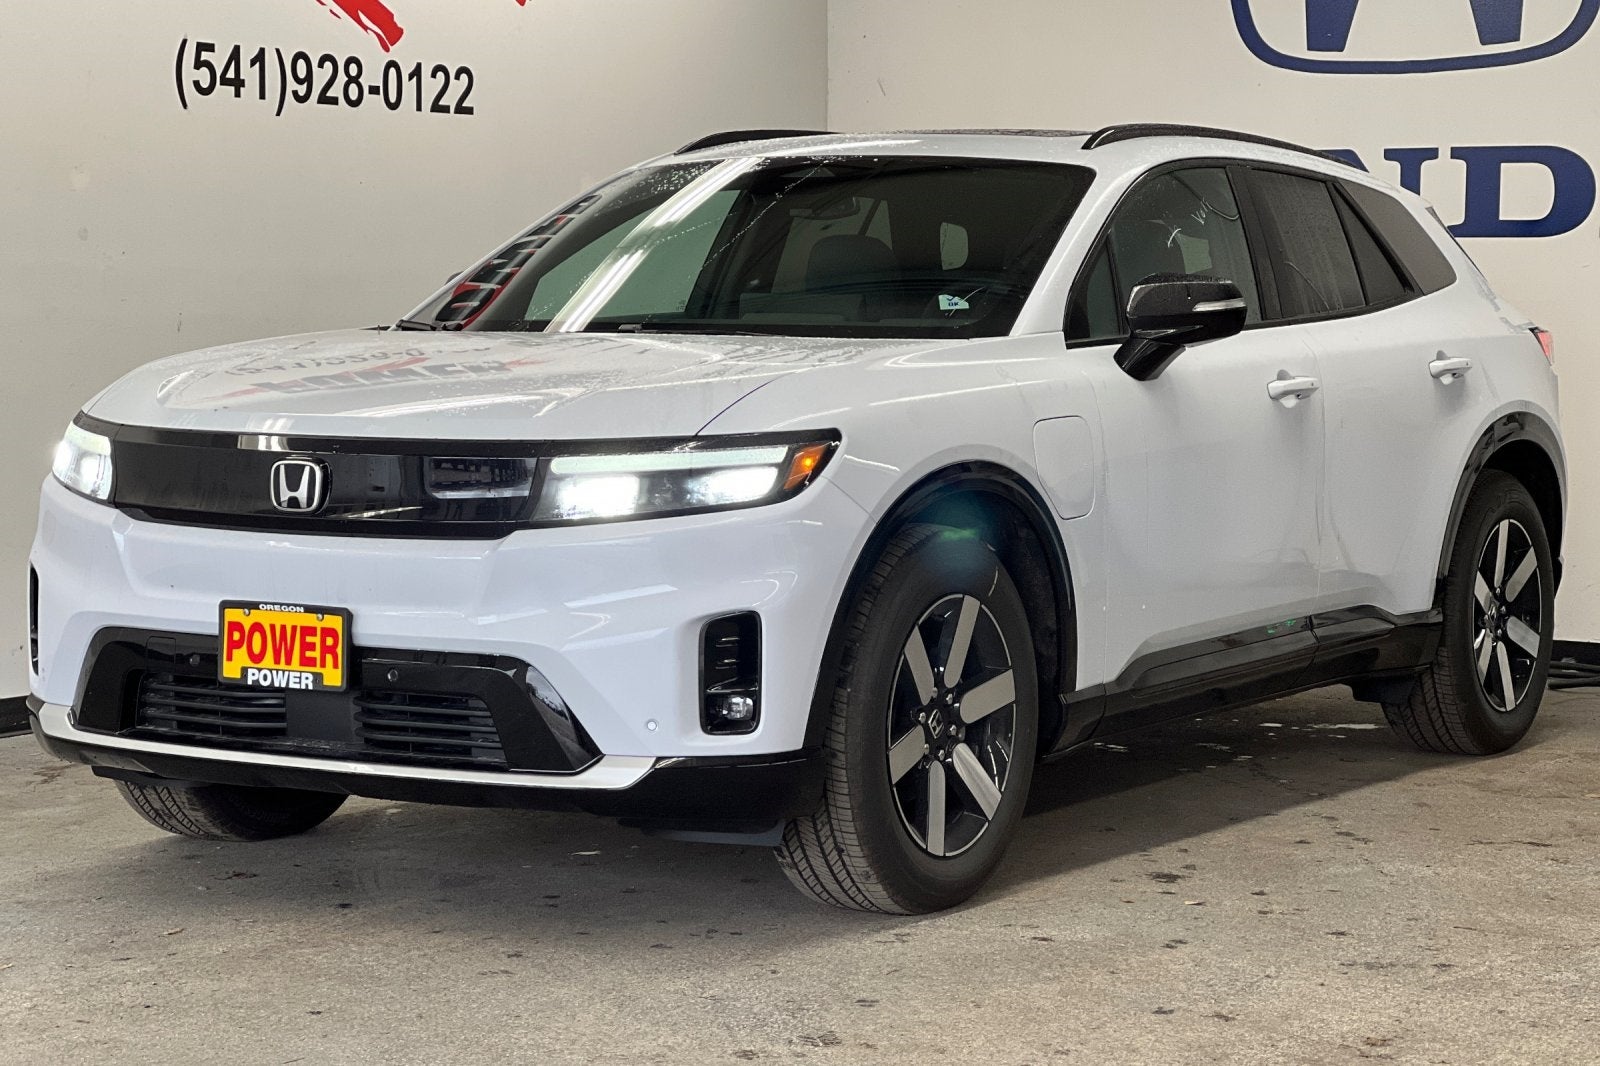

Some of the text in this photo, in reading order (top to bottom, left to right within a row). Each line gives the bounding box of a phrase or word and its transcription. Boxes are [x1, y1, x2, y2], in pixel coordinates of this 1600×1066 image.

[175, 37, 475, 117] (541)928-0122
[258, 603, 305, 613] OREGON
[225, 620, 340, 669] POWER
[246, 667, 314, 690] POWER
